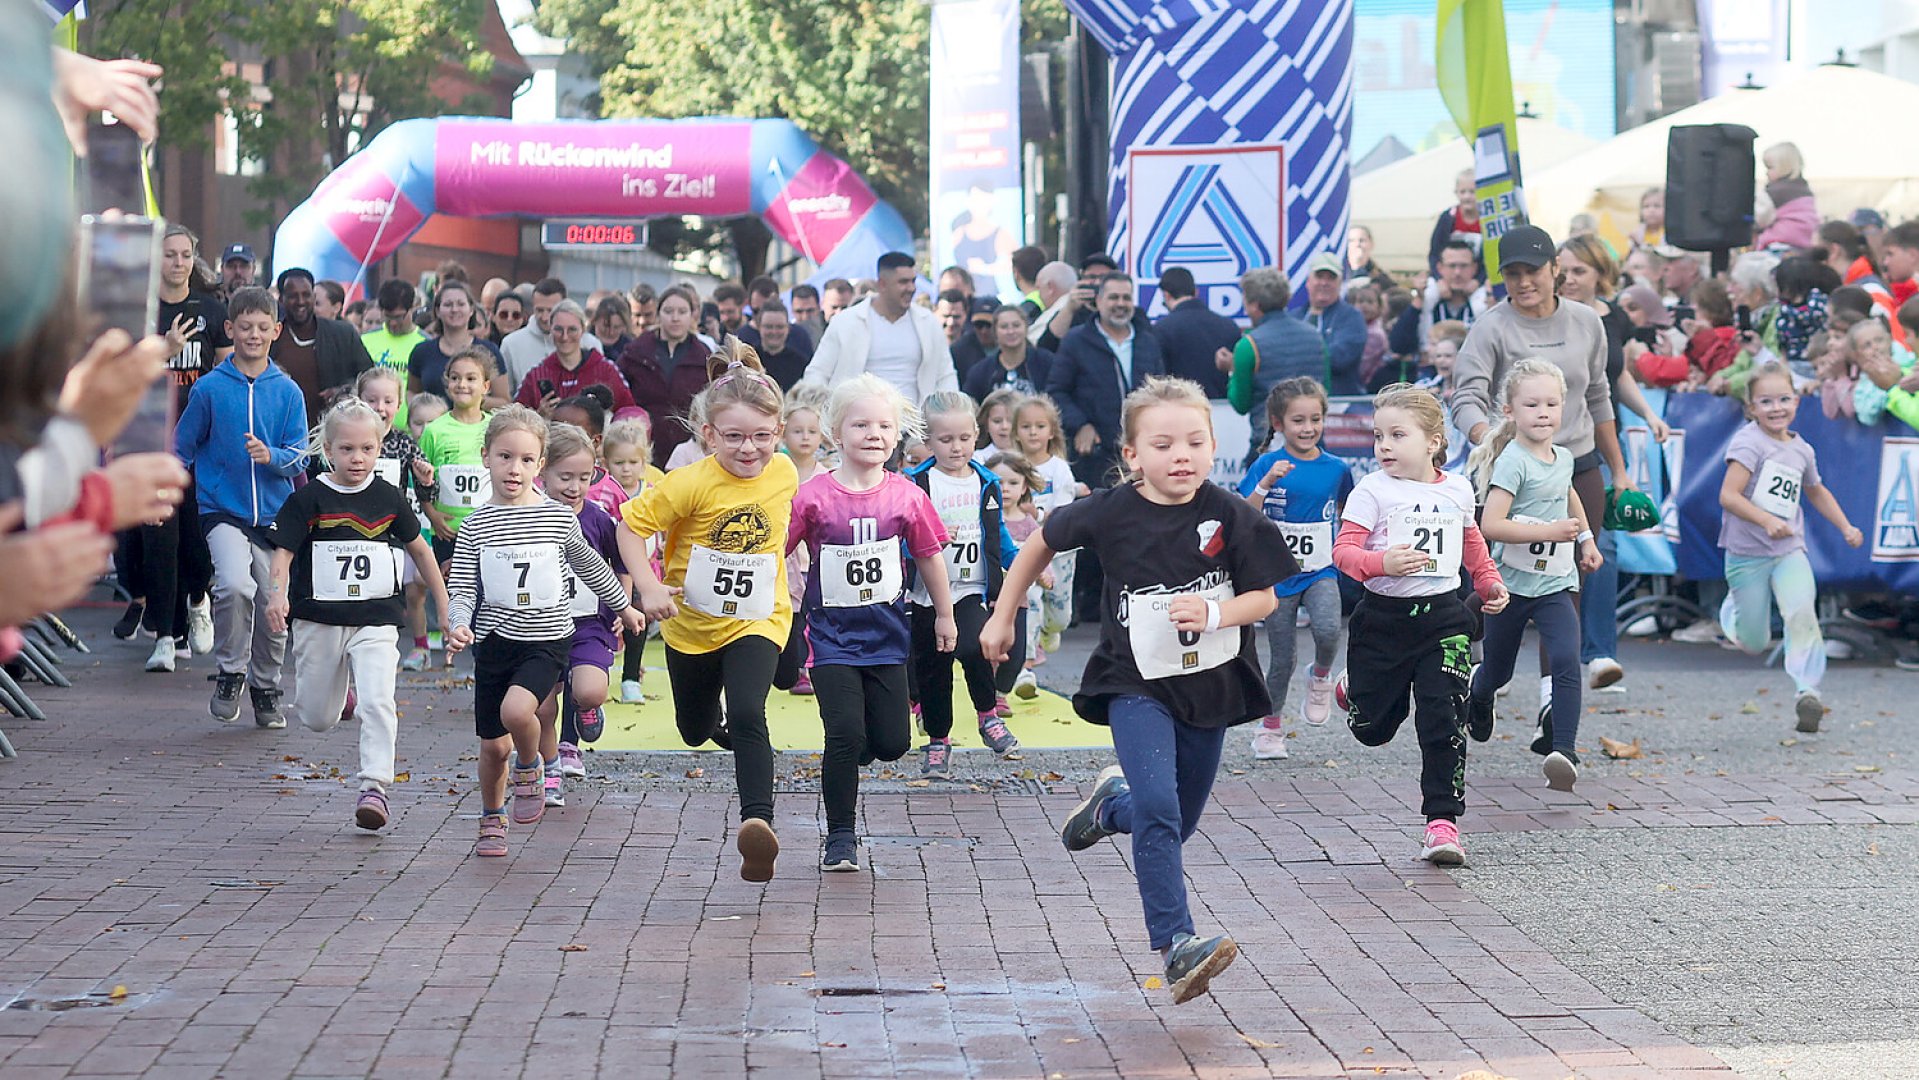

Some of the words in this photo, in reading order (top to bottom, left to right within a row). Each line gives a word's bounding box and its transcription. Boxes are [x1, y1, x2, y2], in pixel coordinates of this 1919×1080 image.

[471, 141, 512, 166] Mit
[518, 140, 673, 168] Rückenwind
[622, 173, 656, 197] ins
[663, 173, 716, 198] Ziel!
[566, 225, 636, 243] 0:00:06
[454, 475, 480, 493] 90
[328, 543, 359, 554] Citylauf
[1285, 534, 1314, 555] 26
[1413, 527, 1443, 555] 21
[495, 551, 527, 560] Citylauf
[709, 553, 744, 567] Citylauf
[836, 548, 869, 558] Citylauf
[951, 542, 978, 564] 70
[335, 554, 371, 581] 79
[513, 562, 531, 588] 7
[846, 557, 883, 586] 68
[713, 567, 755, 598] 55
